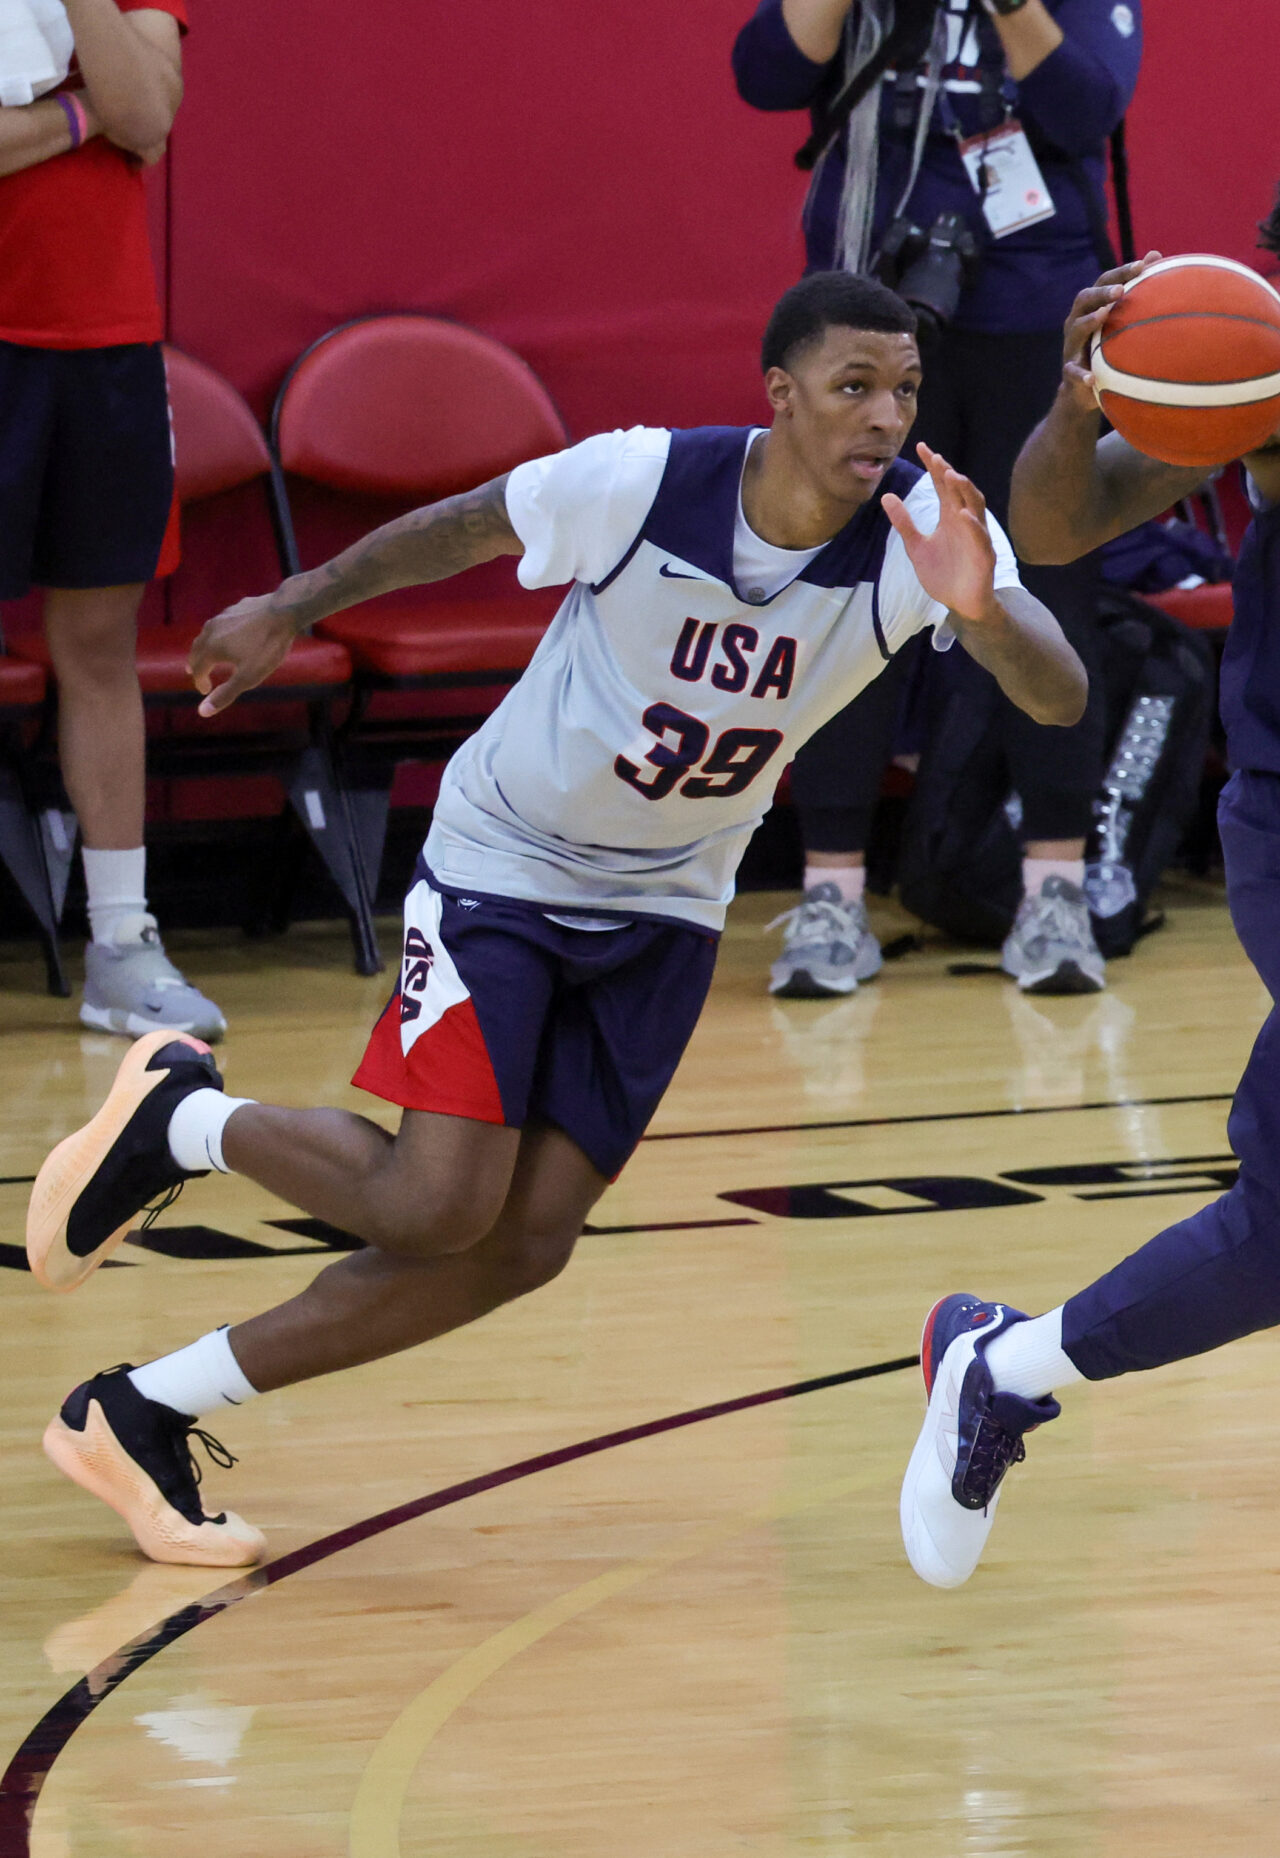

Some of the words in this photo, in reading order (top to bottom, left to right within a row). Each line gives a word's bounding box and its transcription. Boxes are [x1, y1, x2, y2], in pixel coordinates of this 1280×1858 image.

[670, 616, 797, 700] USA
[613, 701, 784, 801] 39
[400, 926, 434, 1026] USA
